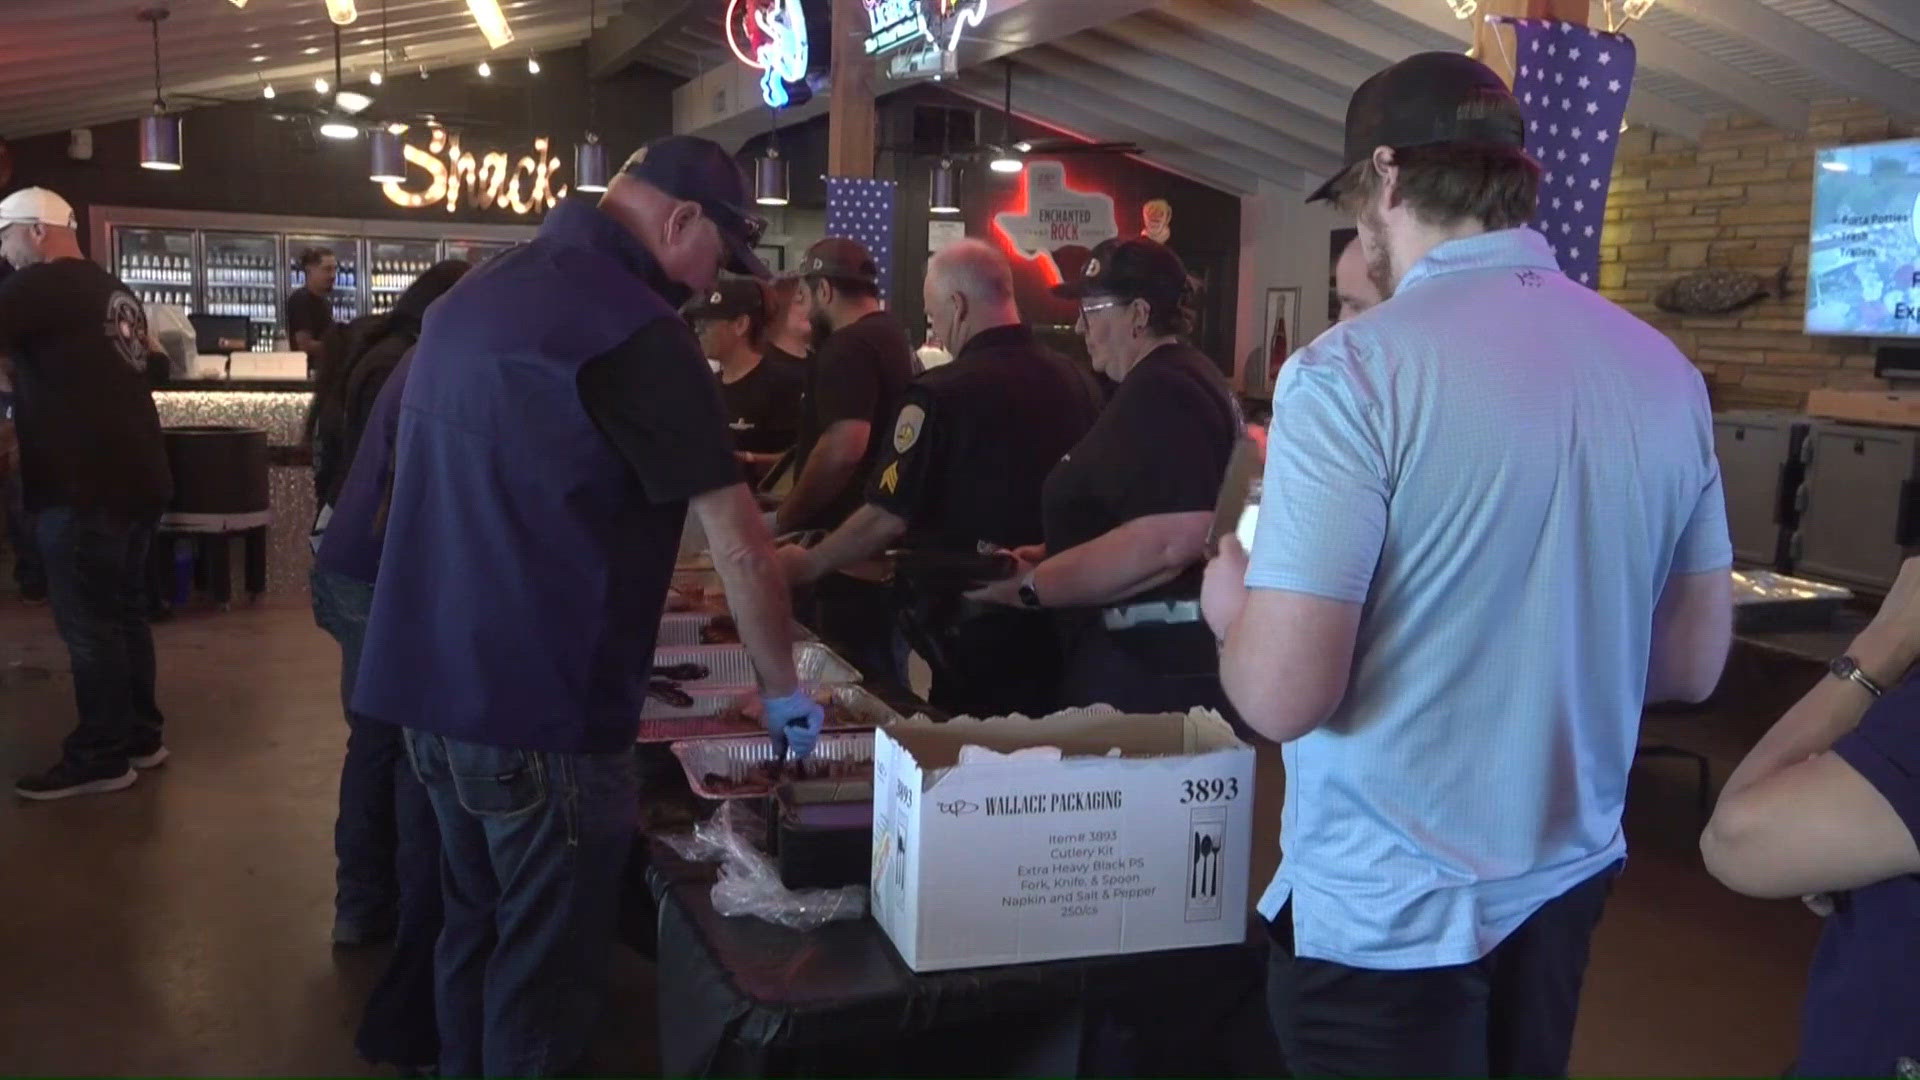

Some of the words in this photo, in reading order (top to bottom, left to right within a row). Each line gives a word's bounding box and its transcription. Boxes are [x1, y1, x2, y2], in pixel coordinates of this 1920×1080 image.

[1039, 208, 1091, 224] ENCHANTED
[1051, 223, 1079, 240] ROCK
[1180, 777, 1239, 804] 3893
[985, 794, 1046, 816] WALLACE
[1051, 790, 1122, 812] PACKAGING
[1049, 833, 1085, 845] Item#
[1089, 830, 1117, 842] 3893
[1050, 847, 1095, 859] Cutlery
[1098, 846, 1114, 856] Kit
[1018, 865, 1048, 876] Extra
[1052, 862, 1089, 874] Heavy
[1093, 860, 1125, 872] Black
[1129, 857, 1145, 868] PS
[1021, 879, 1049, 890] Fork,
[1091, 876, 1099, 886] &
[1102, 874, 1140, 887] Spoon
[1002, 894, 1046, 908] Napkin
[1050, 892, 1073, 903] and
[1077, 889, 1098, 901] Salt
[1102, 889, 1110, 899] &
[1113, 886, 1157, 898] Pepper
[1061, 906, 1099, 917] 250/cs
